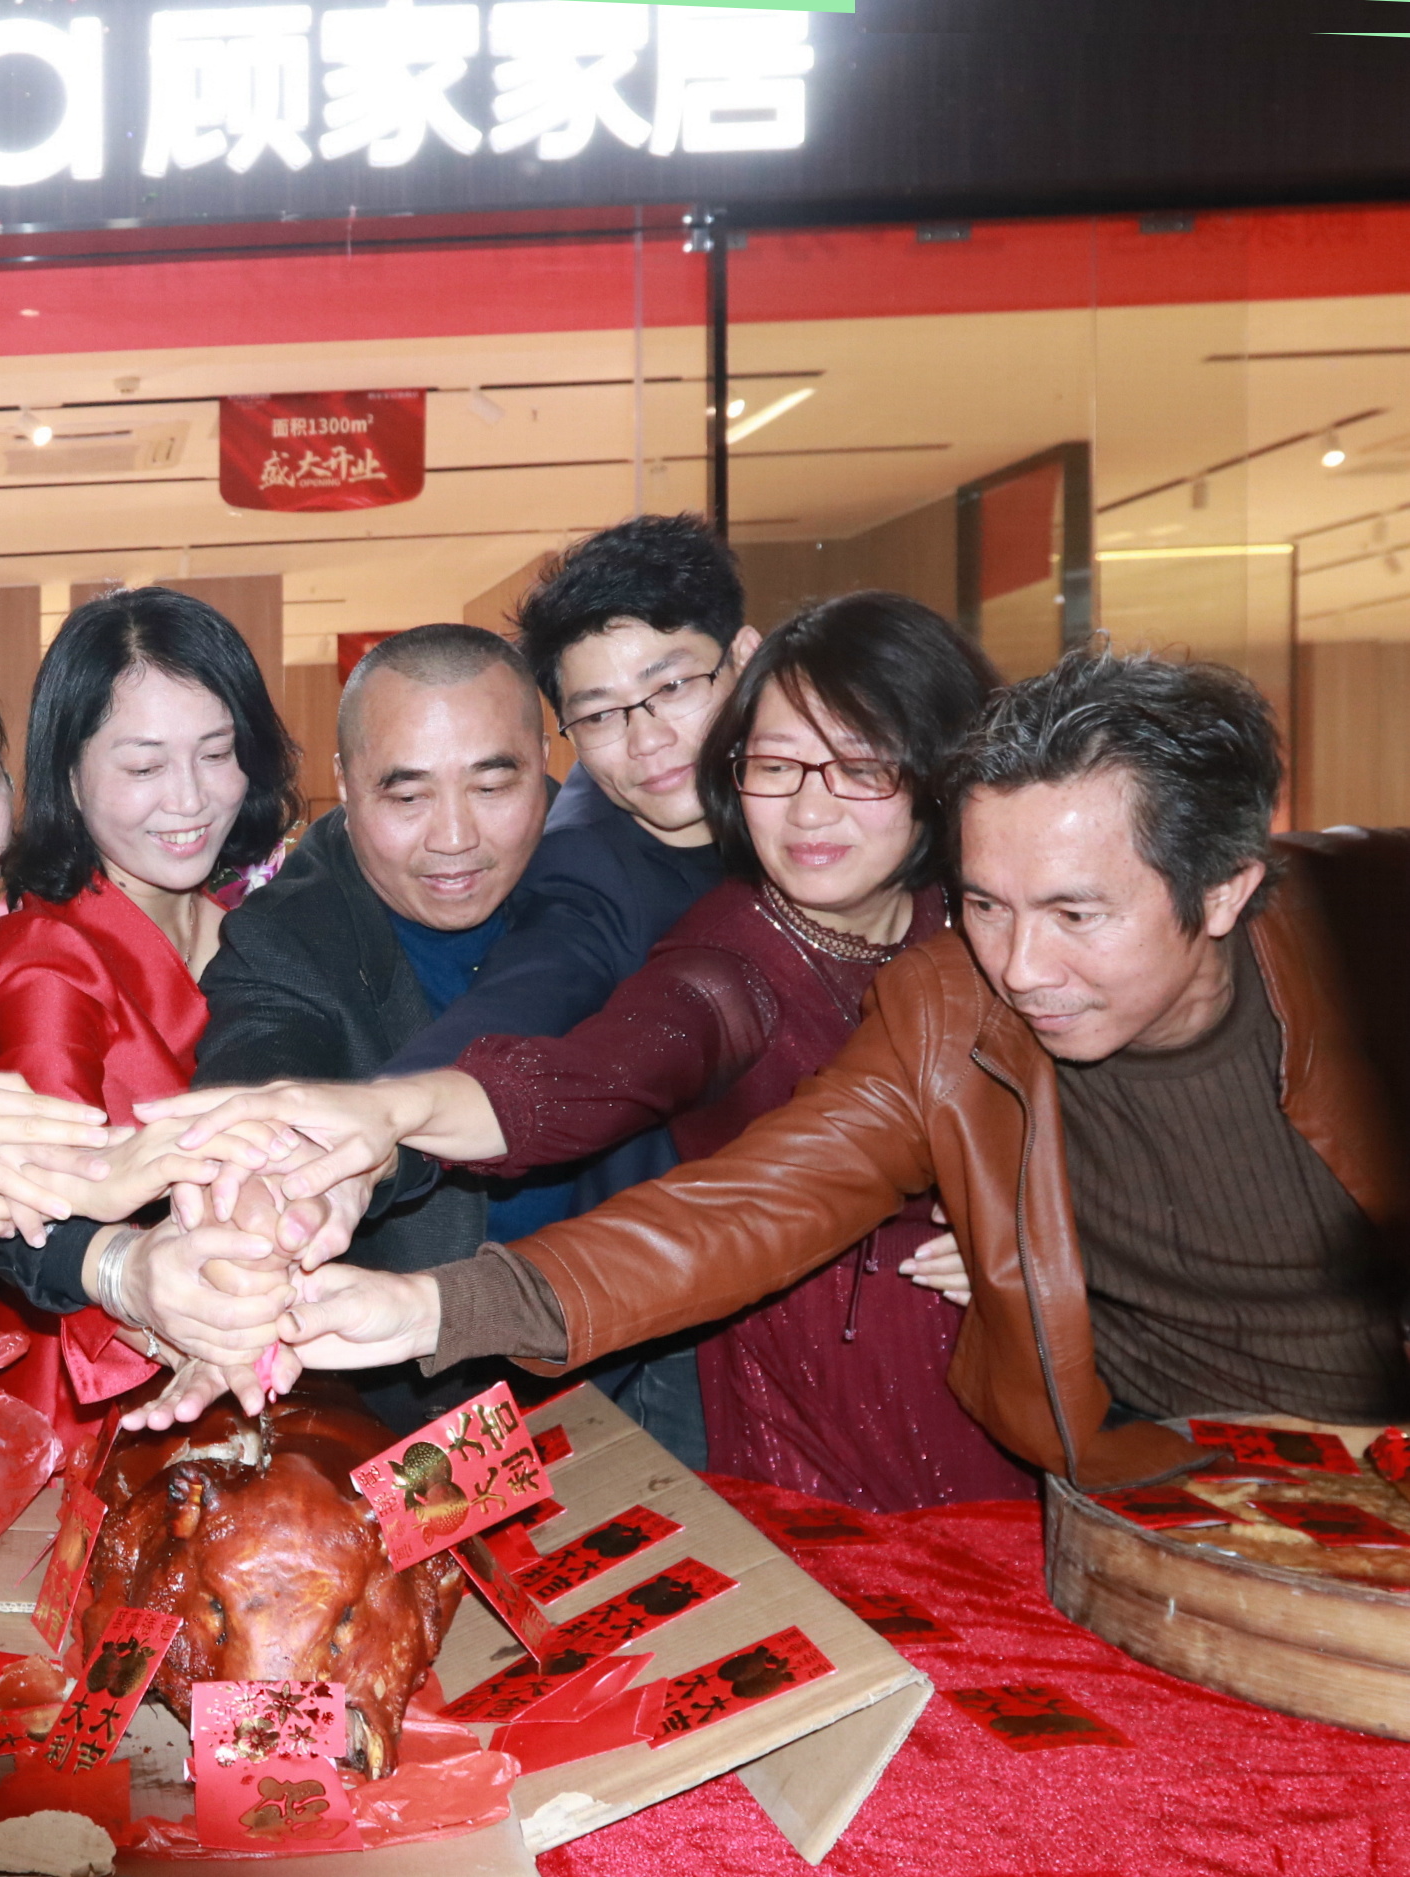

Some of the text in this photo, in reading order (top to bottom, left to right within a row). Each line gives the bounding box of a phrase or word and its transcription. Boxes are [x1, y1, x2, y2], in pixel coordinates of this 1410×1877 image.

[140, 0, 816, 178] 顾家家居
[259, 446, 387, 490] 盛大开业
